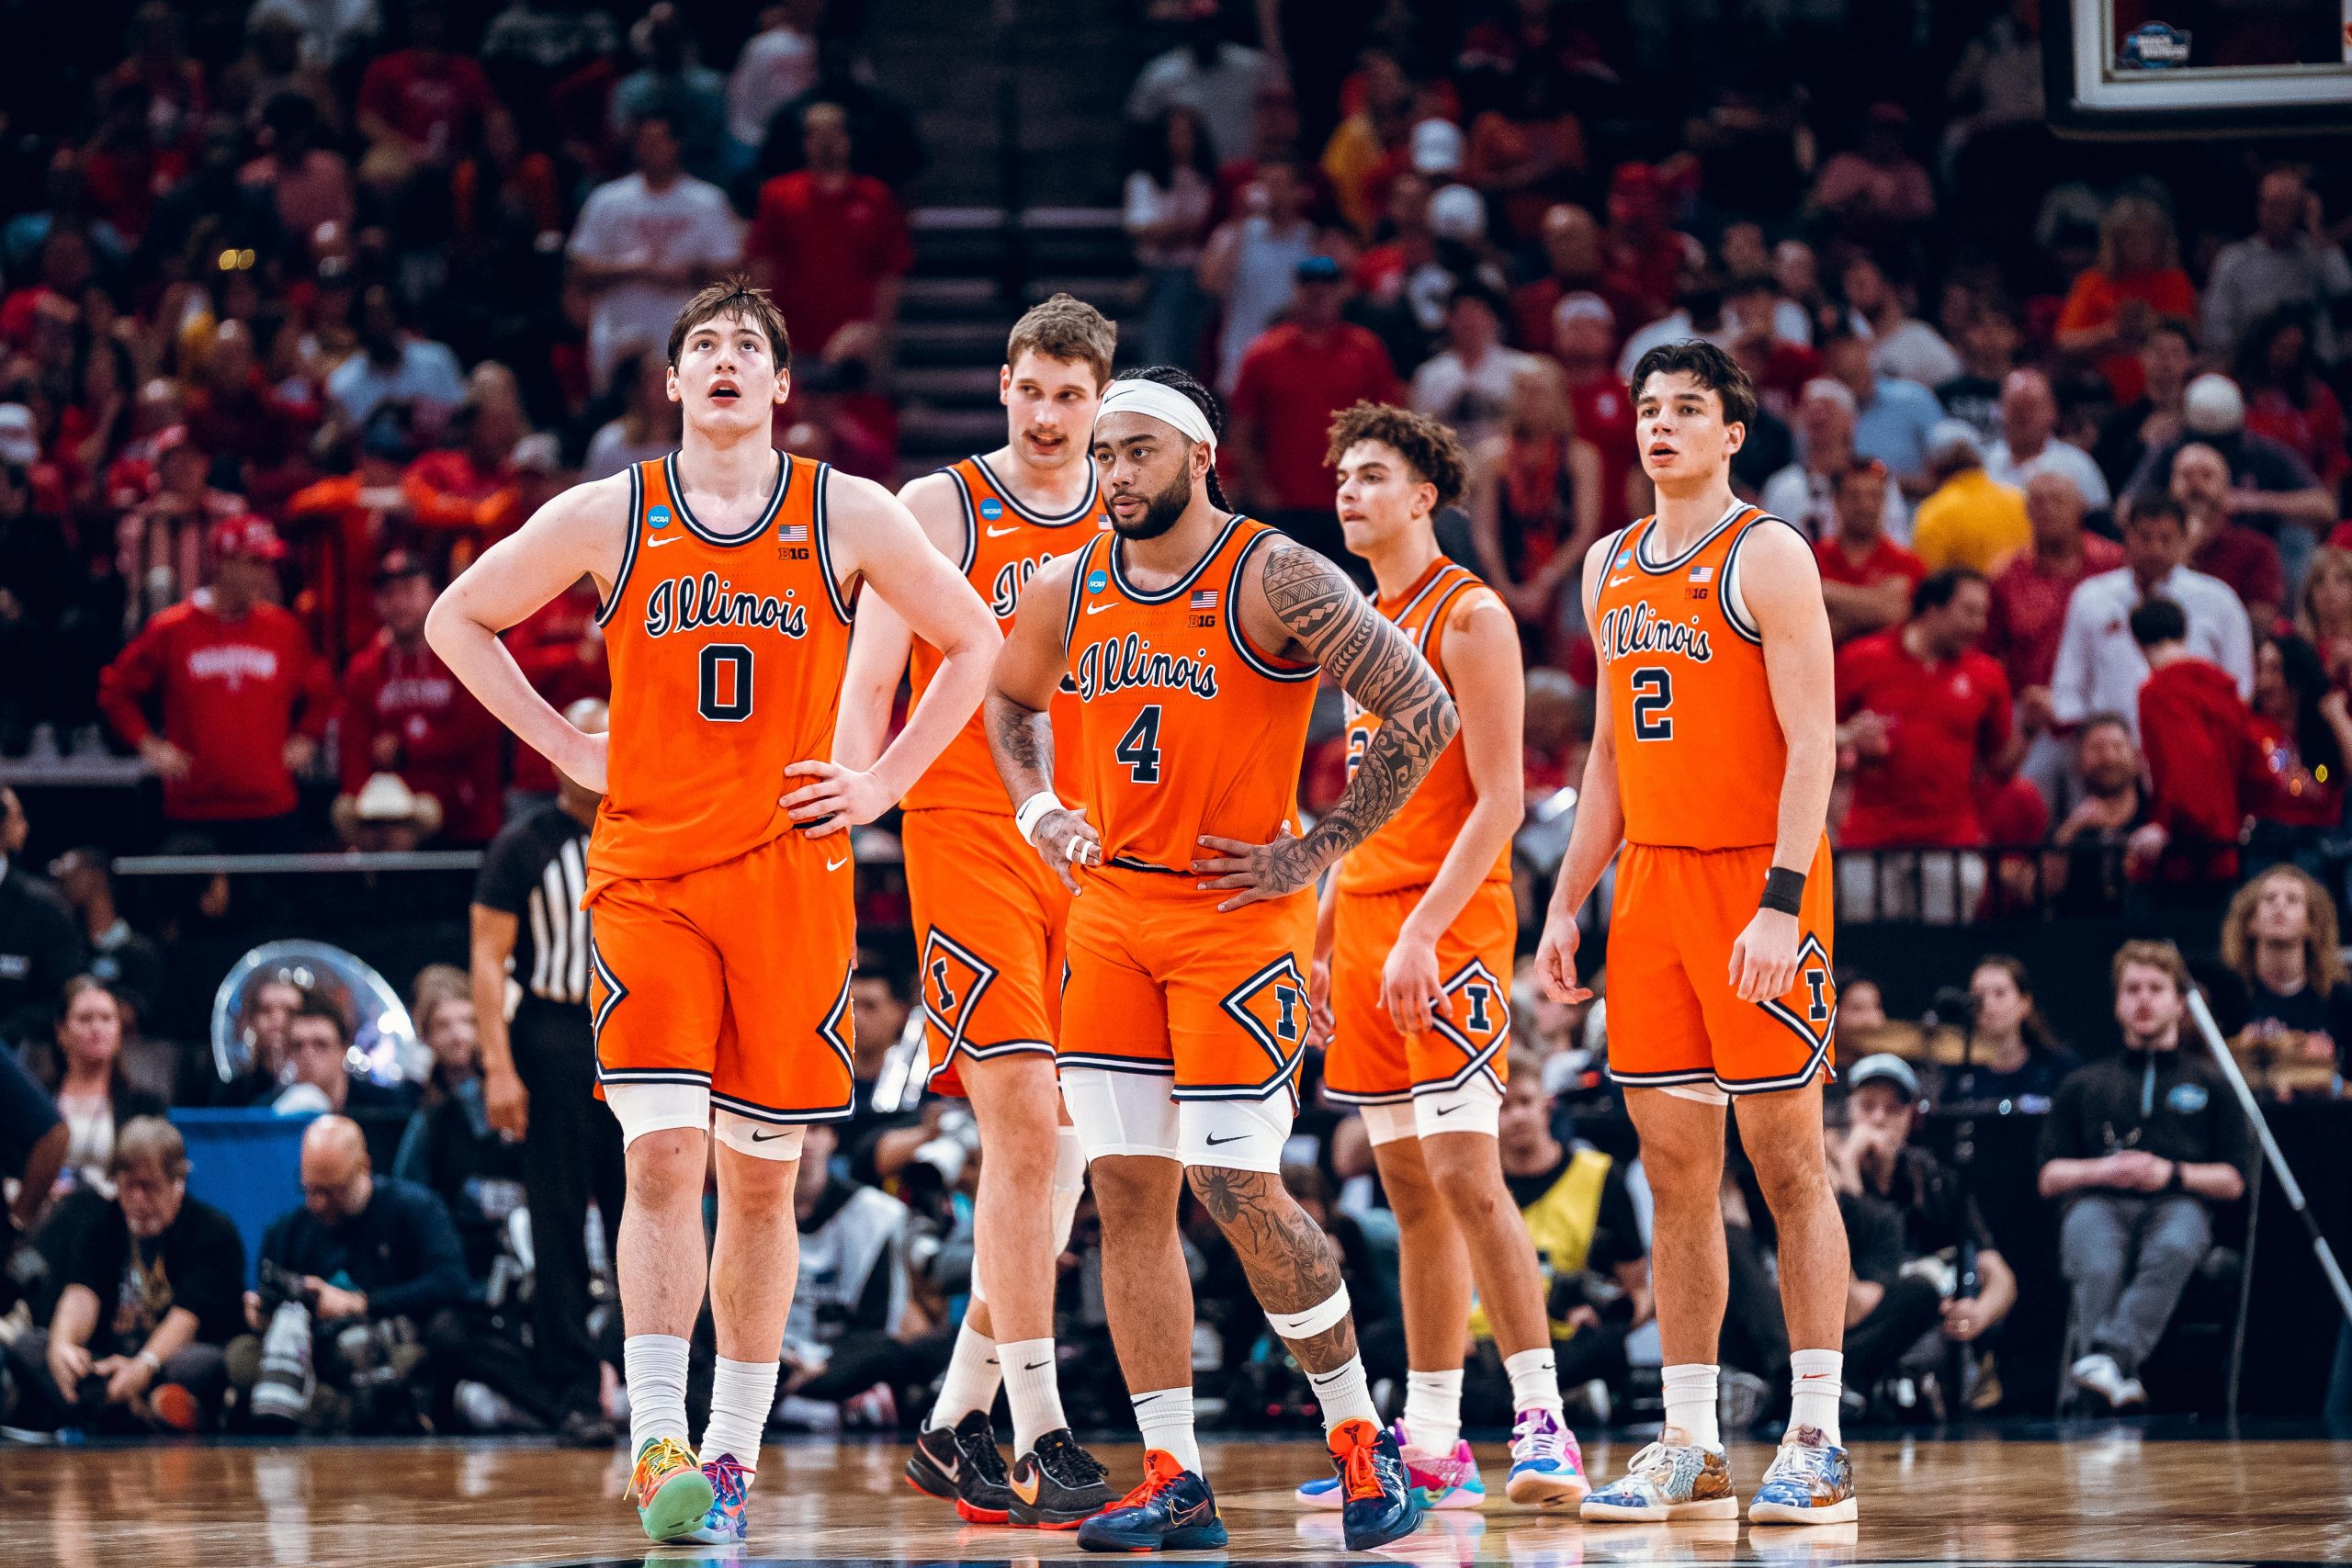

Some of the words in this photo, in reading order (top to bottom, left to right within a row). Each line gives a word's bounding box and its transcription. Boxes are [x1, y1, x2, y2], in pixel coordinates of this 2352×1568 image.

[650, 515, 669, 524] NCAA
[644, 570, 808, 639] Illinois
[1600, 599, 1713, 666] Illinois
[697, 643, 754, 723] 0
[1078, 631, 1219, 704] Illinois
[1631, 666, 1674, 742] 2
[1114, 704, 1162, 784] 4
[1274, 984, 1298, 1043] I
[1464, 983, 1493, 1034] I
[1804, 968, 1828, 1022] I
